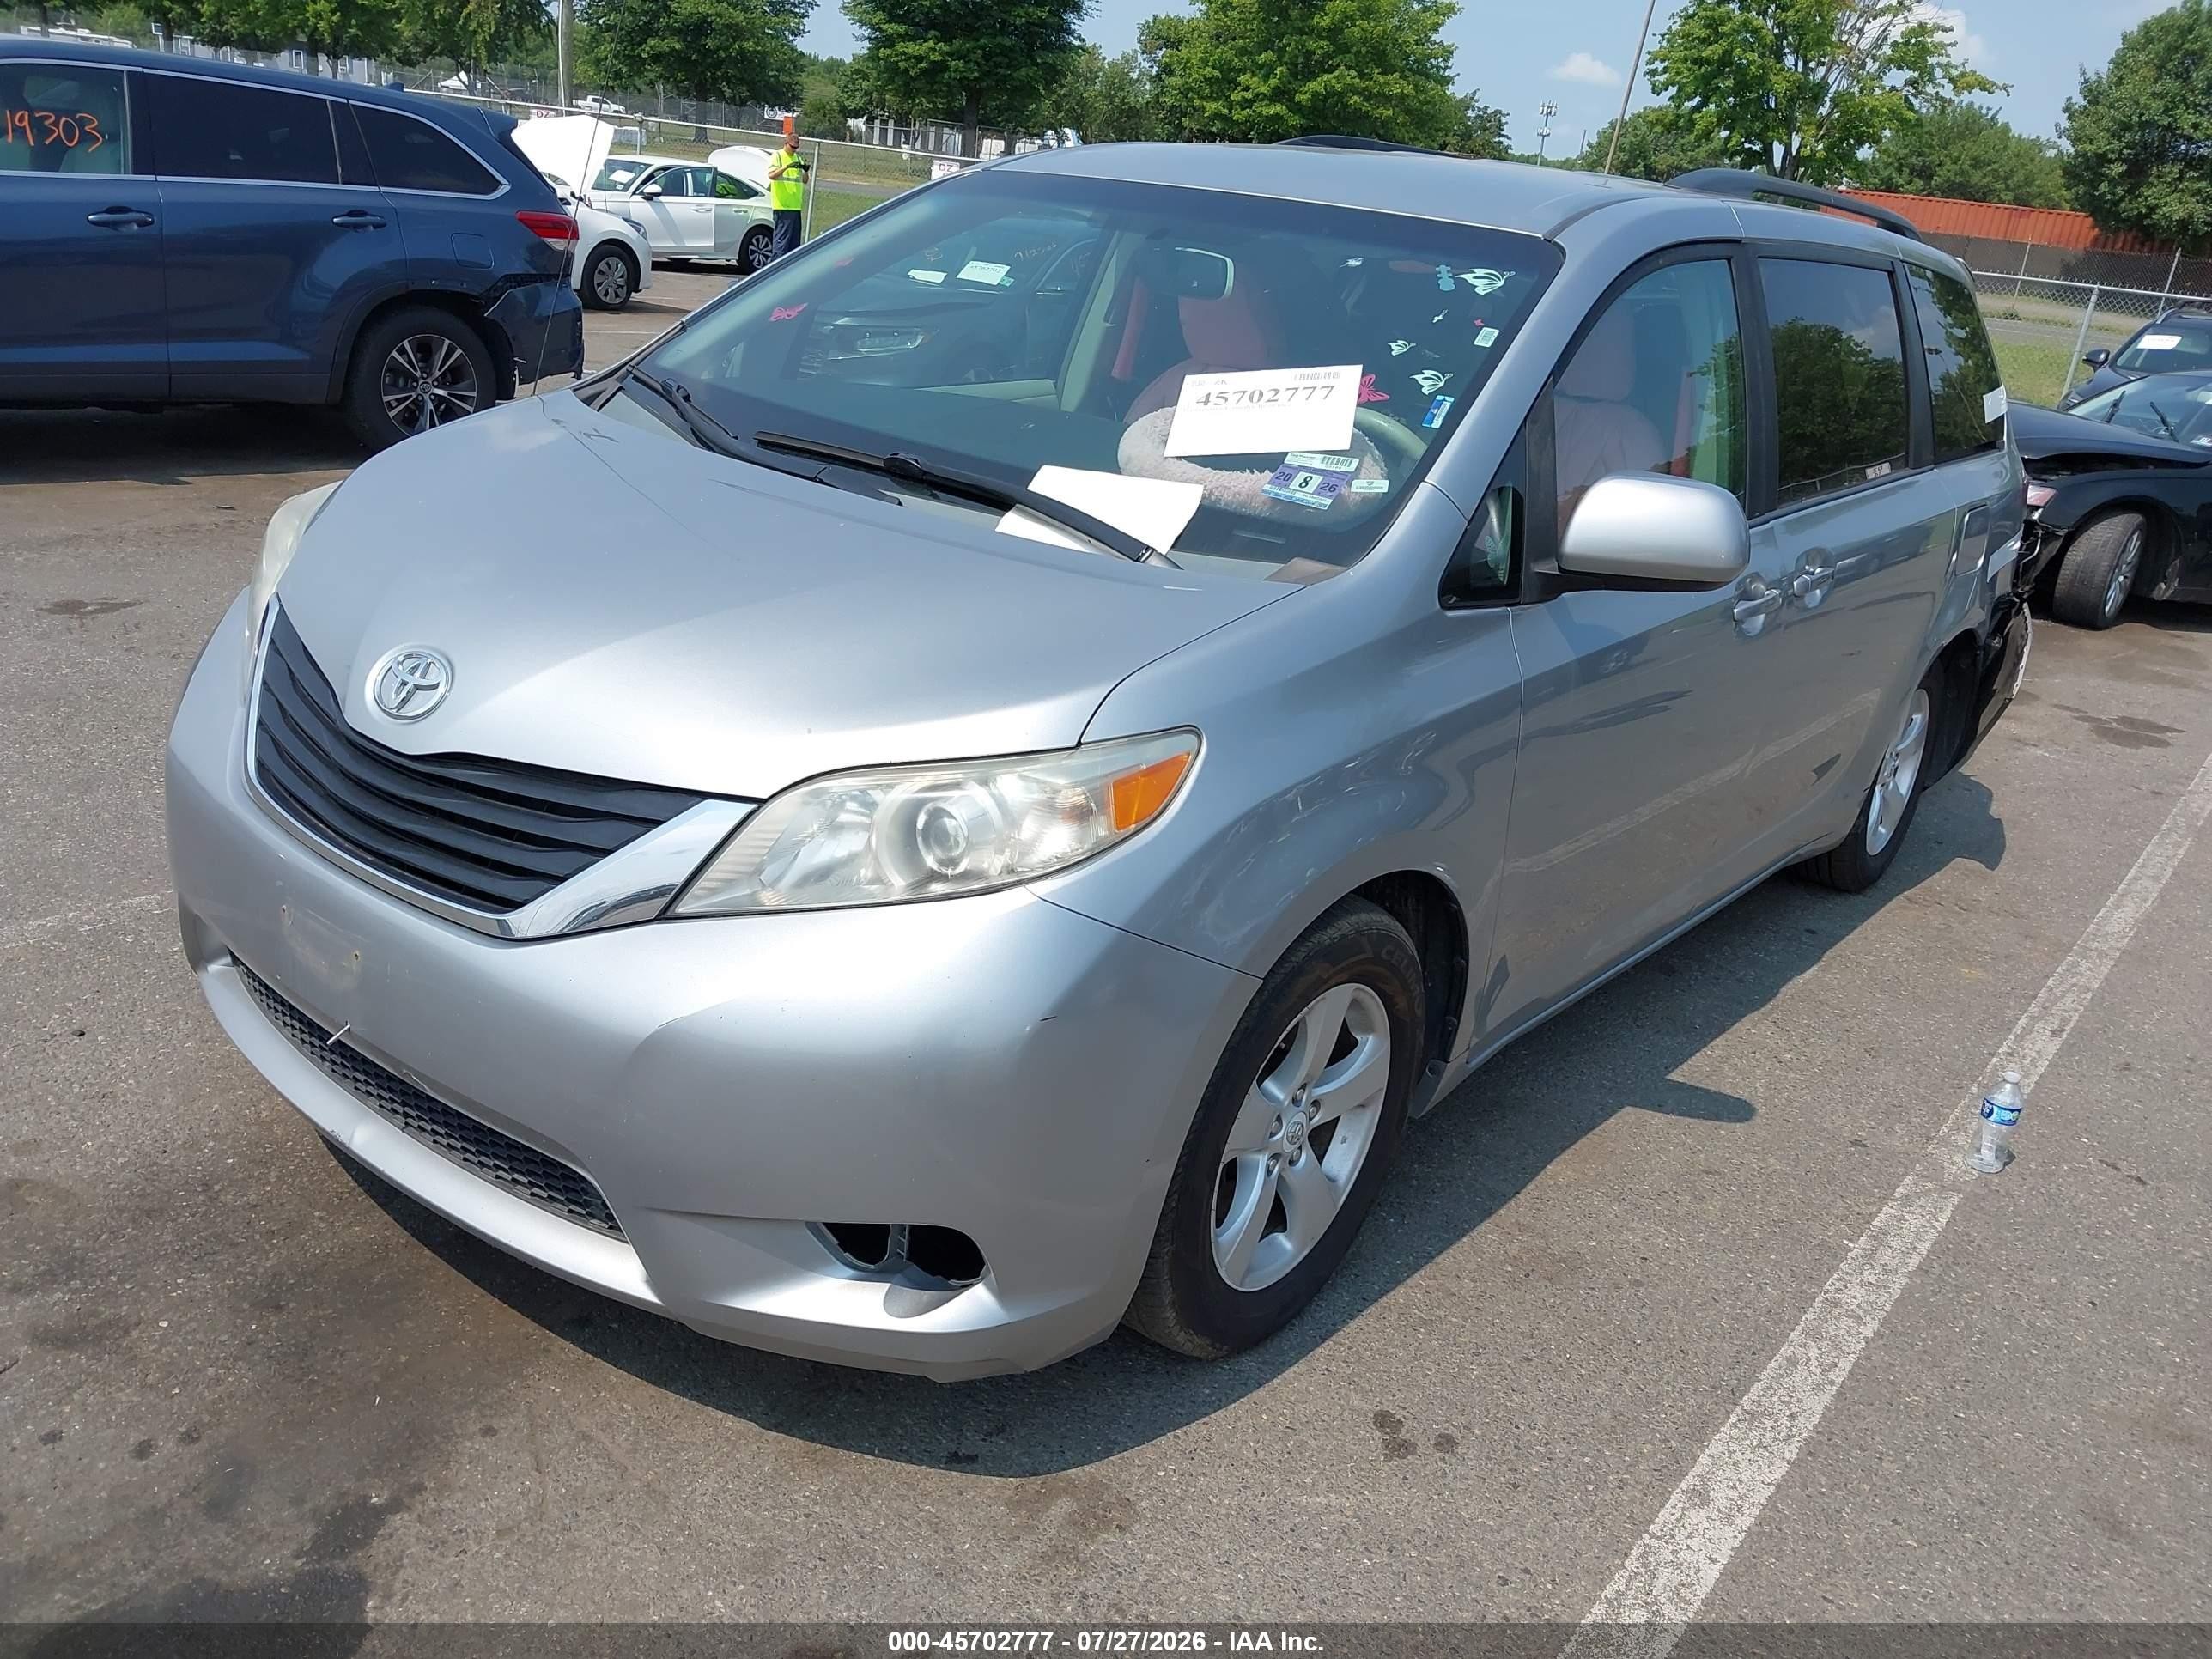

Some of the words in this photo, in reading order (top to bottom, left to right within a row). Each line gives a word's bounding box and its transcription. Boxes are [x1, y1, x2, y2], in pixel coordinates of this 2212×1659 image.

[5, 109, 103, 152] 19303
[1196, 386, 1336, 406] 45702777
[1275, 471, 1293, 482] 20
[1298, 475, 1313, 489] 8
[1319, 482, 1339, 493] 26
